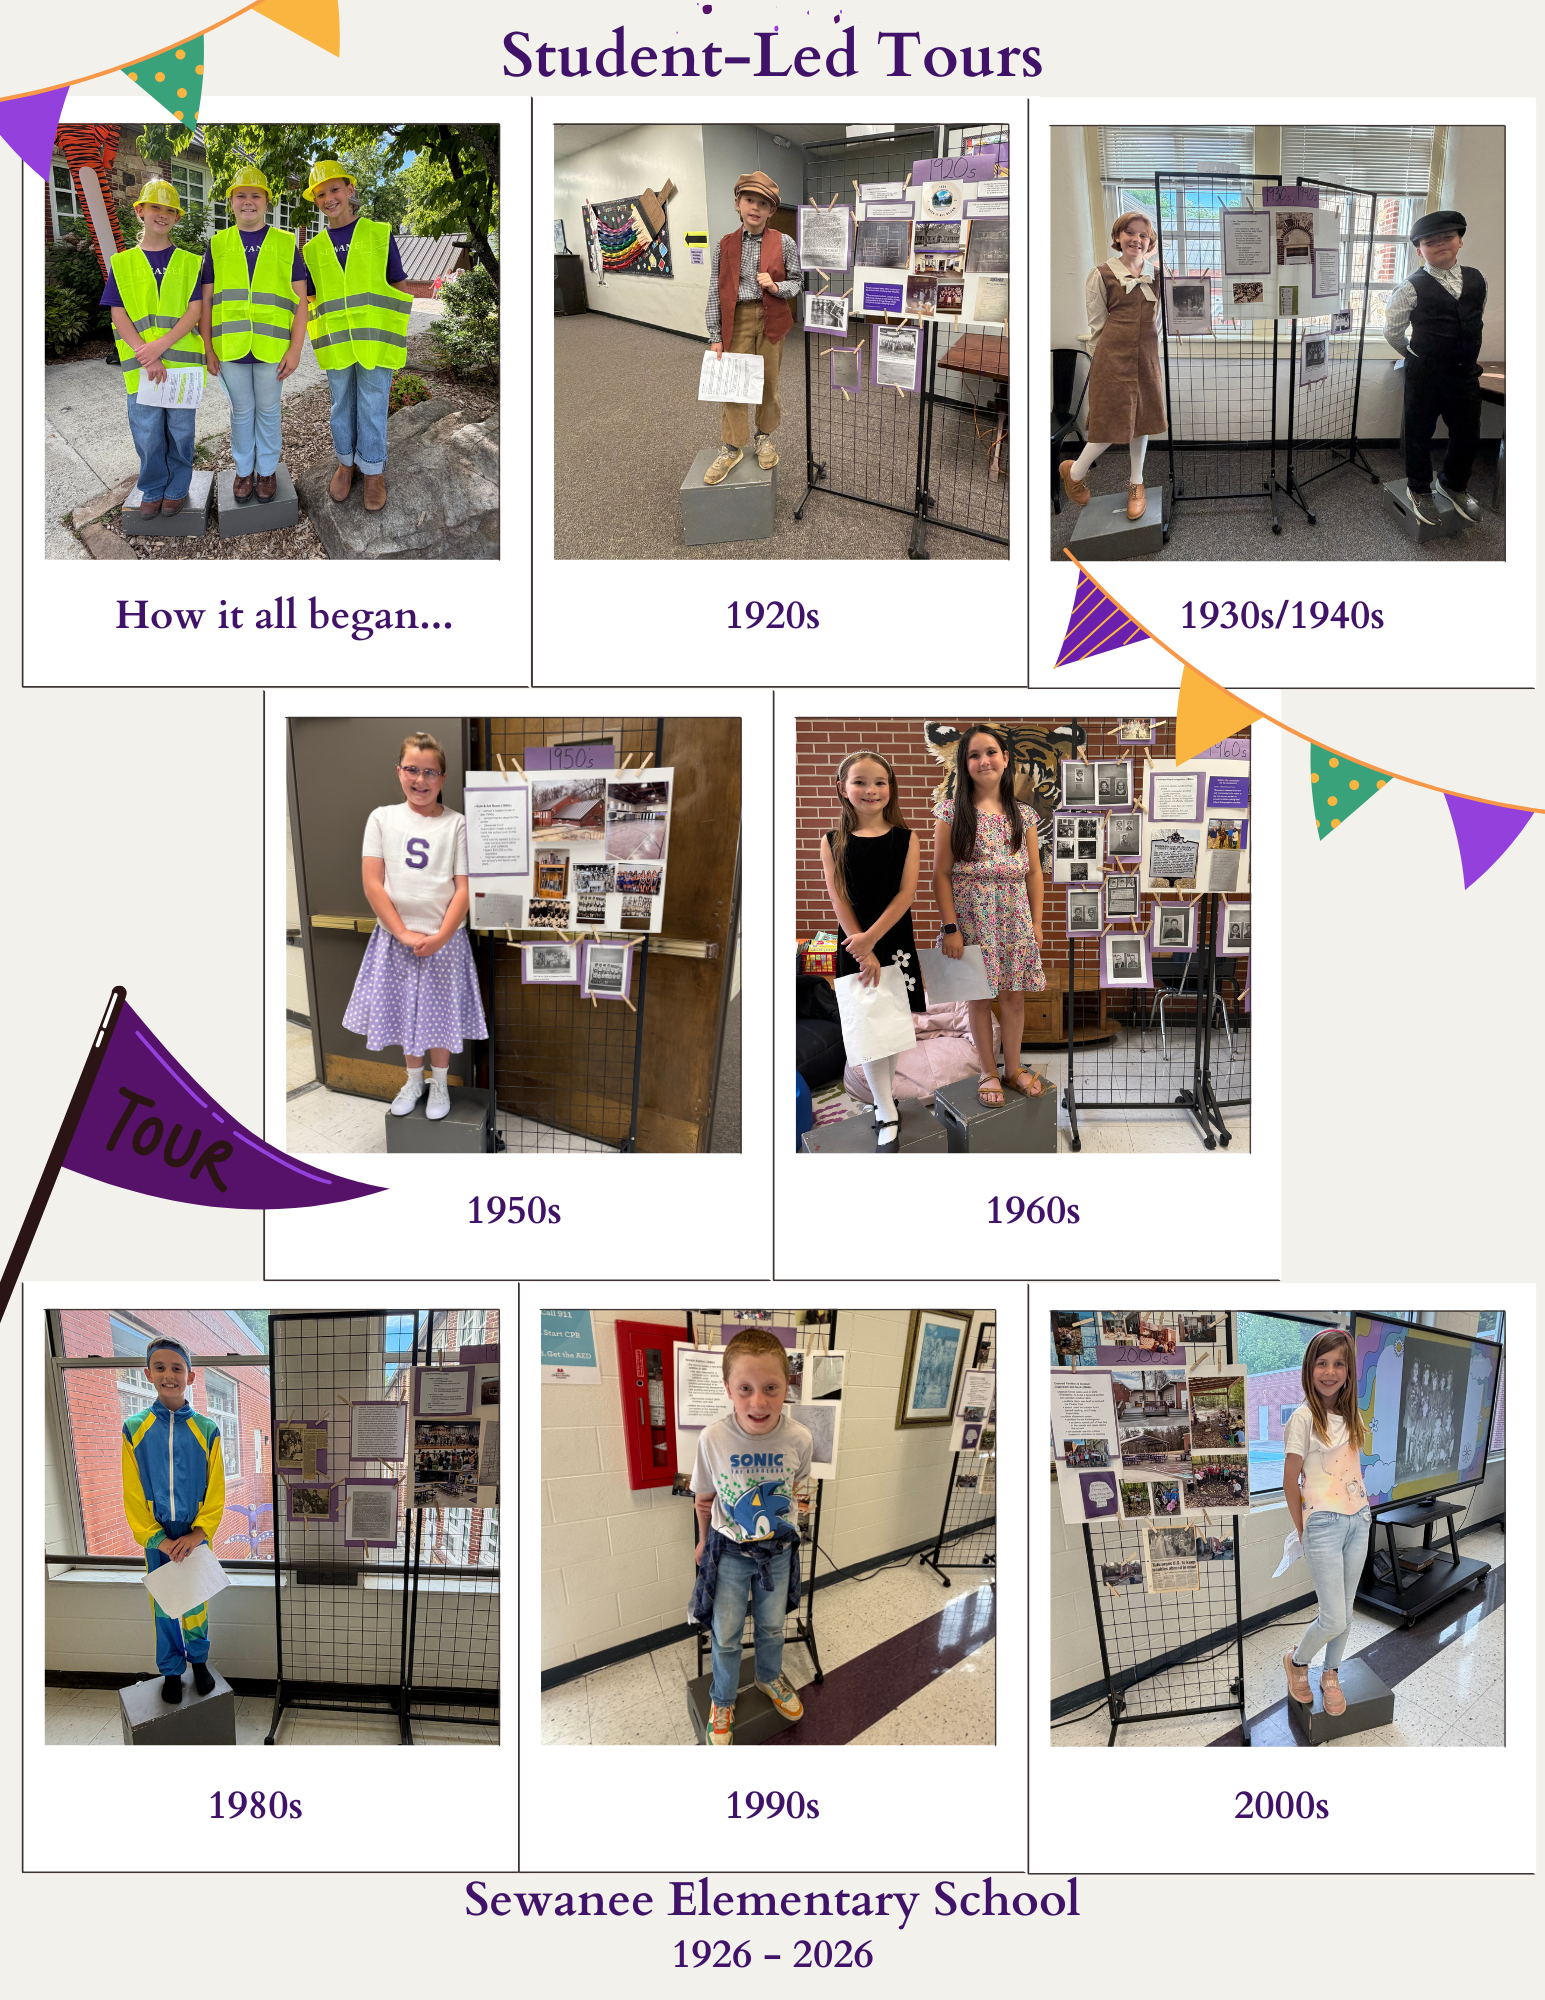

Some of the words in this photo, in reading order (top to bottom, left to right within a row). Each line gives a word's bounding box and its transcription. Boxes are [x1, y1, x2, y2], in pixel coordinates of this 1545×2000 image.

[930, 157, 977, 181] 1920s
[549, 747, 594, 770] 1950's
[405, 837, 430, 869] S
[557, 1311, 573, 1319] 911
[543, 1329, 563, 1338] Start
[564, 1331, 581, 1339] CPR
[546, 1350, 561, 1358] Get
[562, 1351, 575, 1359] the
[576, 1352, 592, 1360] AED
[1116, 1346, 1169, 1365] 2000s
[730, 1453, 784, 1467] SONIC
